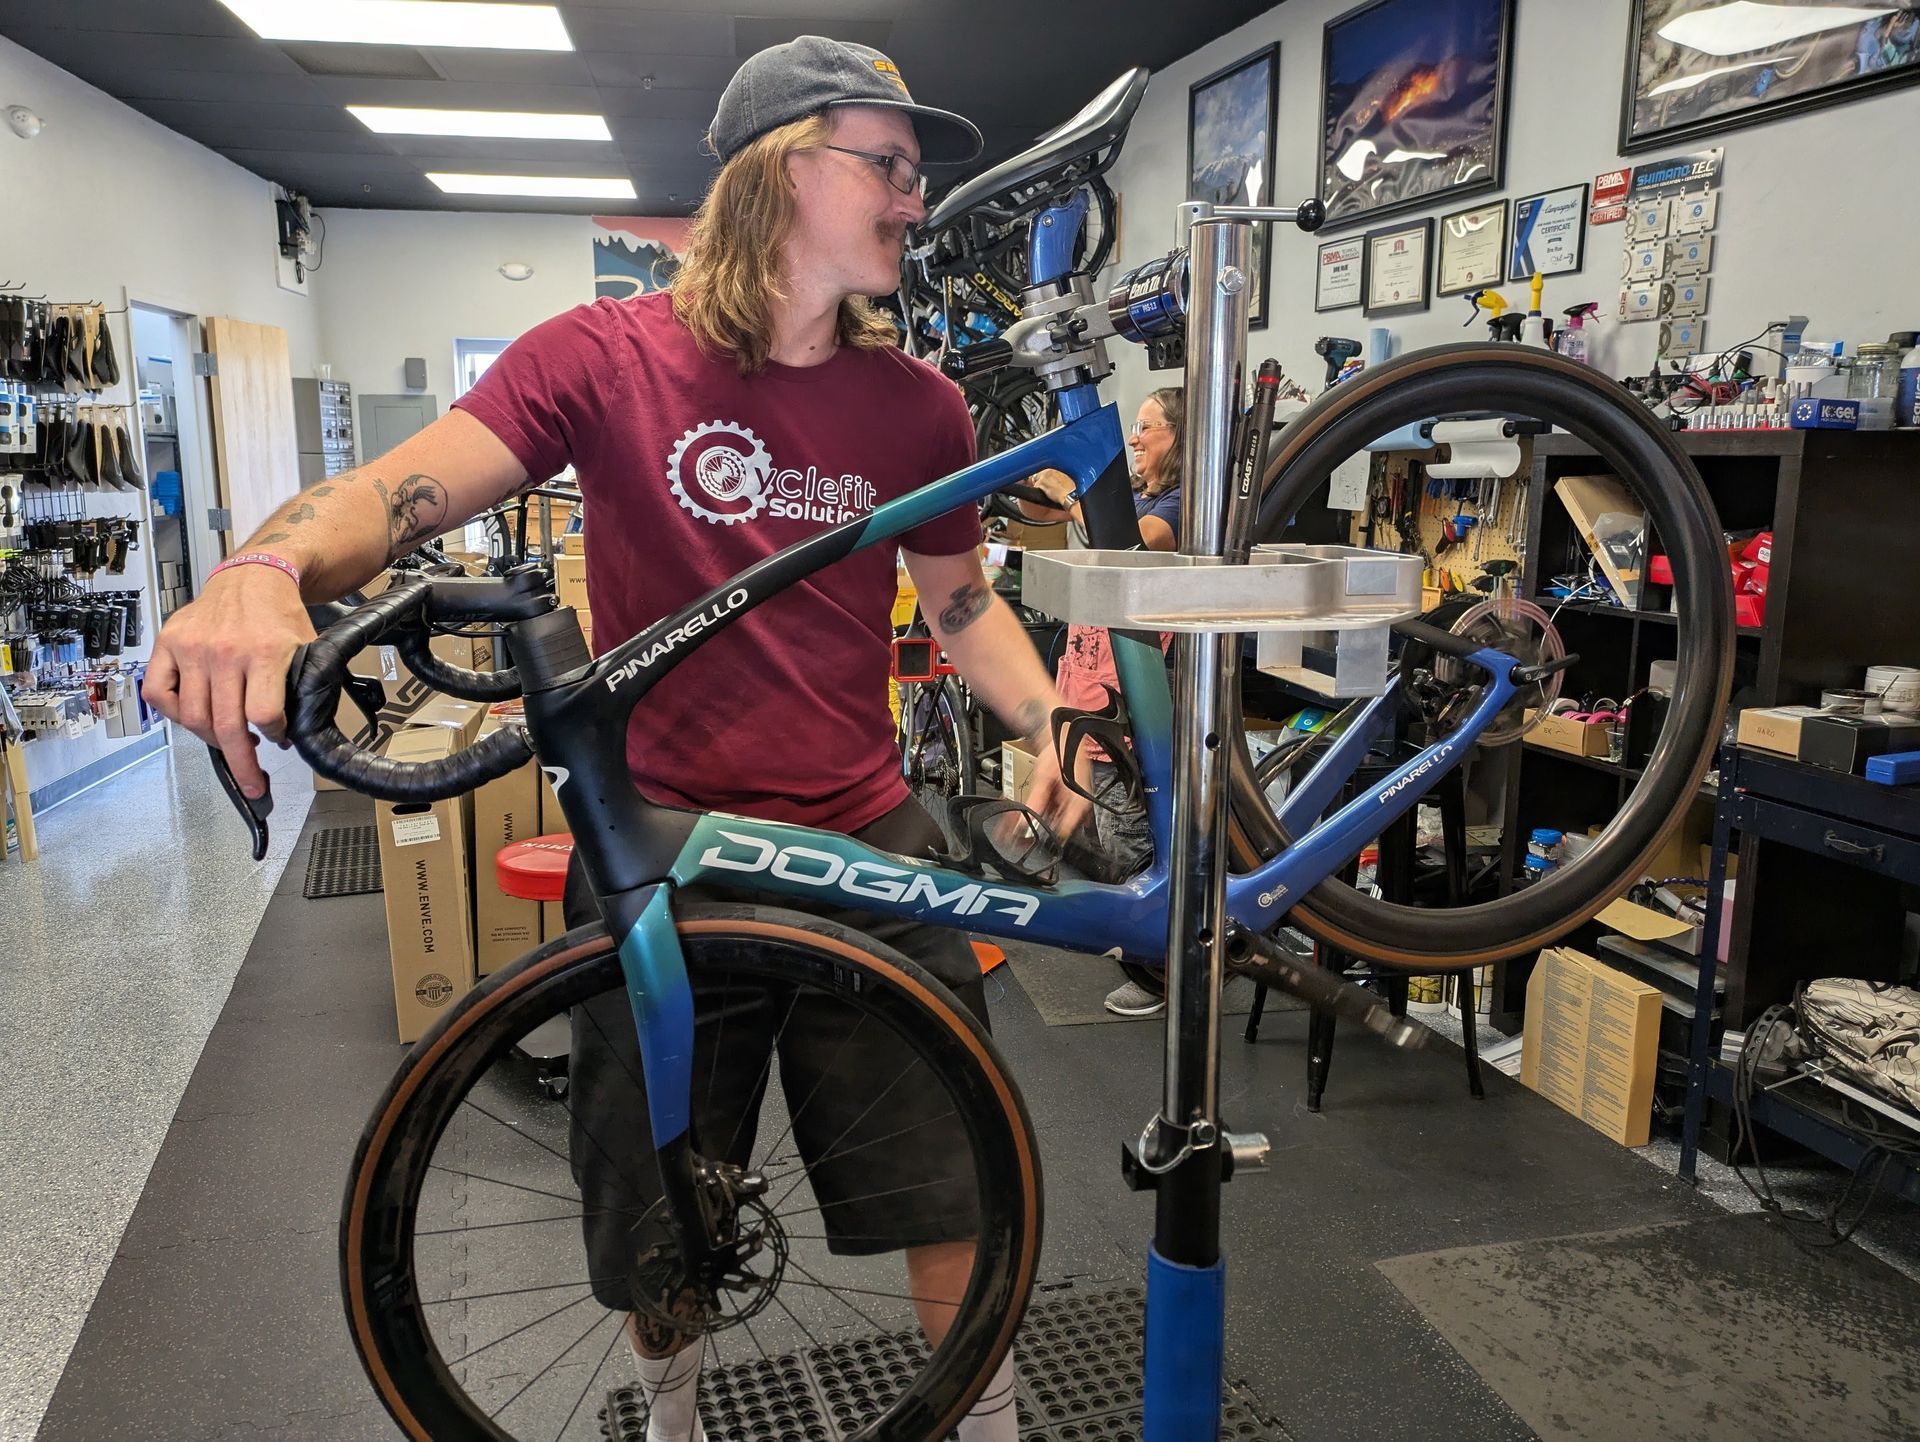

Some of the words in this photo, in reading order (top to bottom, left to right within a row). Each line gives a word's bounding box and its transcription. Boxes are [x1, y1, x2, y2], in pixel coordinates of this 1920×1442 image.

[1597, 172, 1625, 189] PBMA
[1637, 165, 1690, 186] SHIMANO
[1592, 207, 1622, 222] CERTIFIED
[1541, 222, 1571, 234] CERTIFICATE
[1129, 281, 1149, 301] Park
[1242, 458, 1252, 493] COAST
[224, 554, 269, 567] 2026
[605, 588, 748, 693] PINARELLO
[699, 830, 1040, 927] DOGMA
[415, 859, 435, 953] WWW.ENVE.COM
